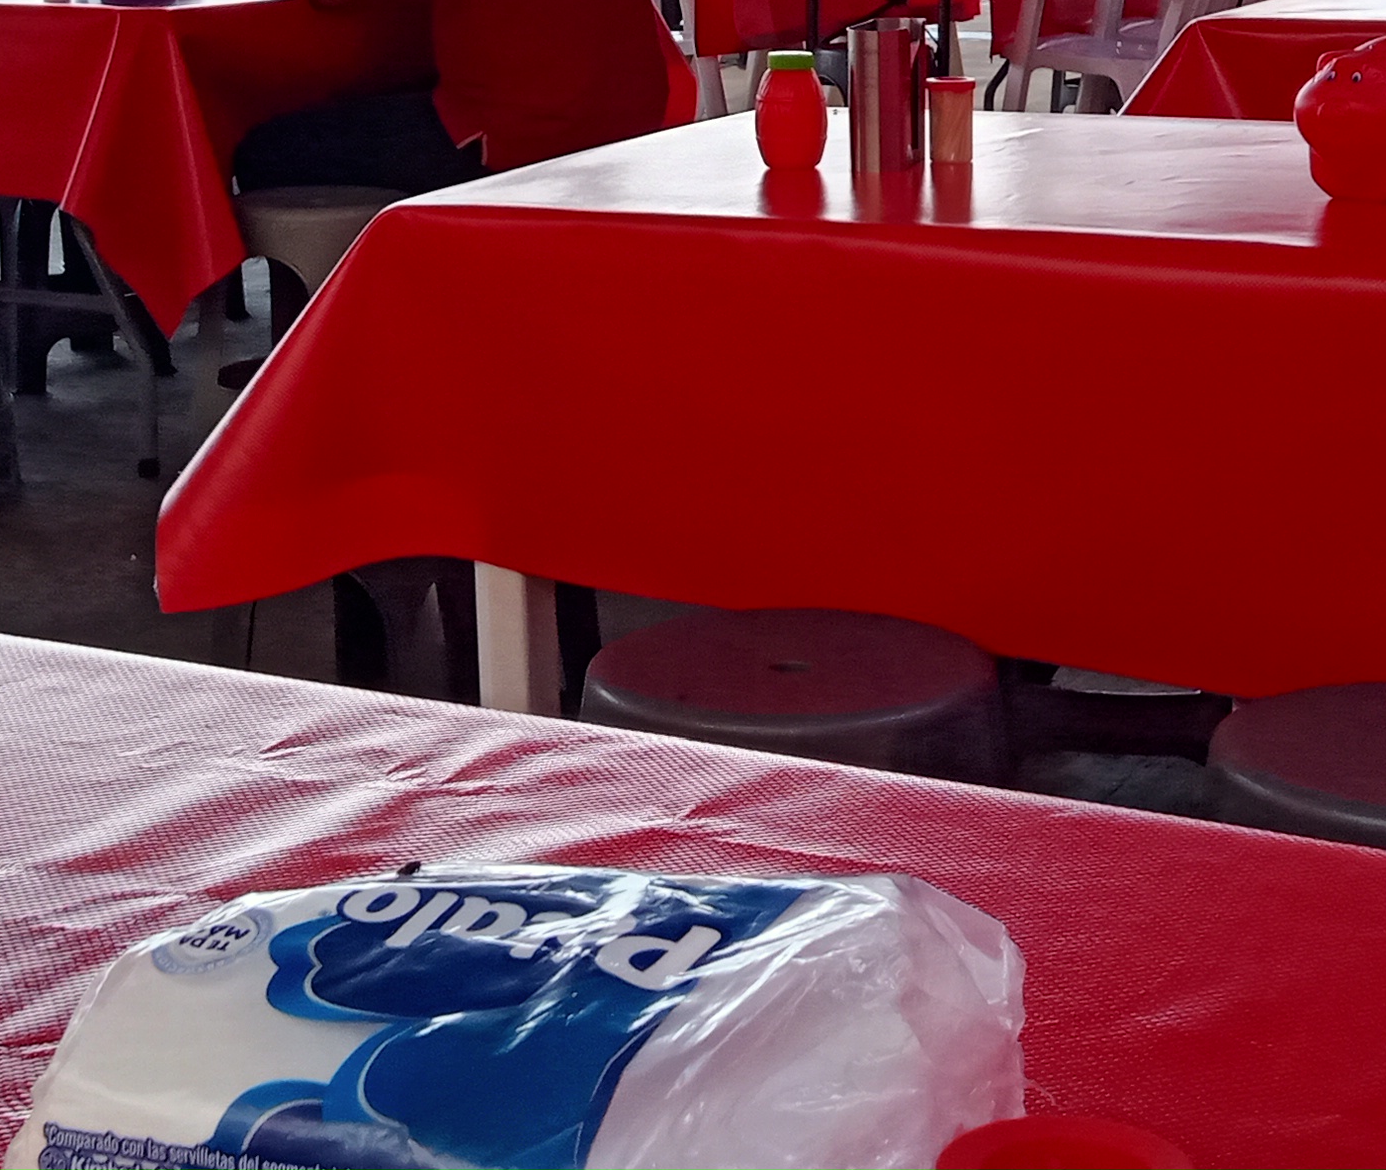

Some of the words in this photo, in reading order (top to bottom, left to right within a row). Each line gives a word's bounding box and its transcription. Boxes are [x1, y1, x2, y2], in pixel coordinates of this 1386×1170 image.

[342, 886, 721, 991] Ptalo
[121, 1139, 144, 1158] con
[147, 1138, 167, 1162] las
[169, 1144, 235, 1170] servilletas
